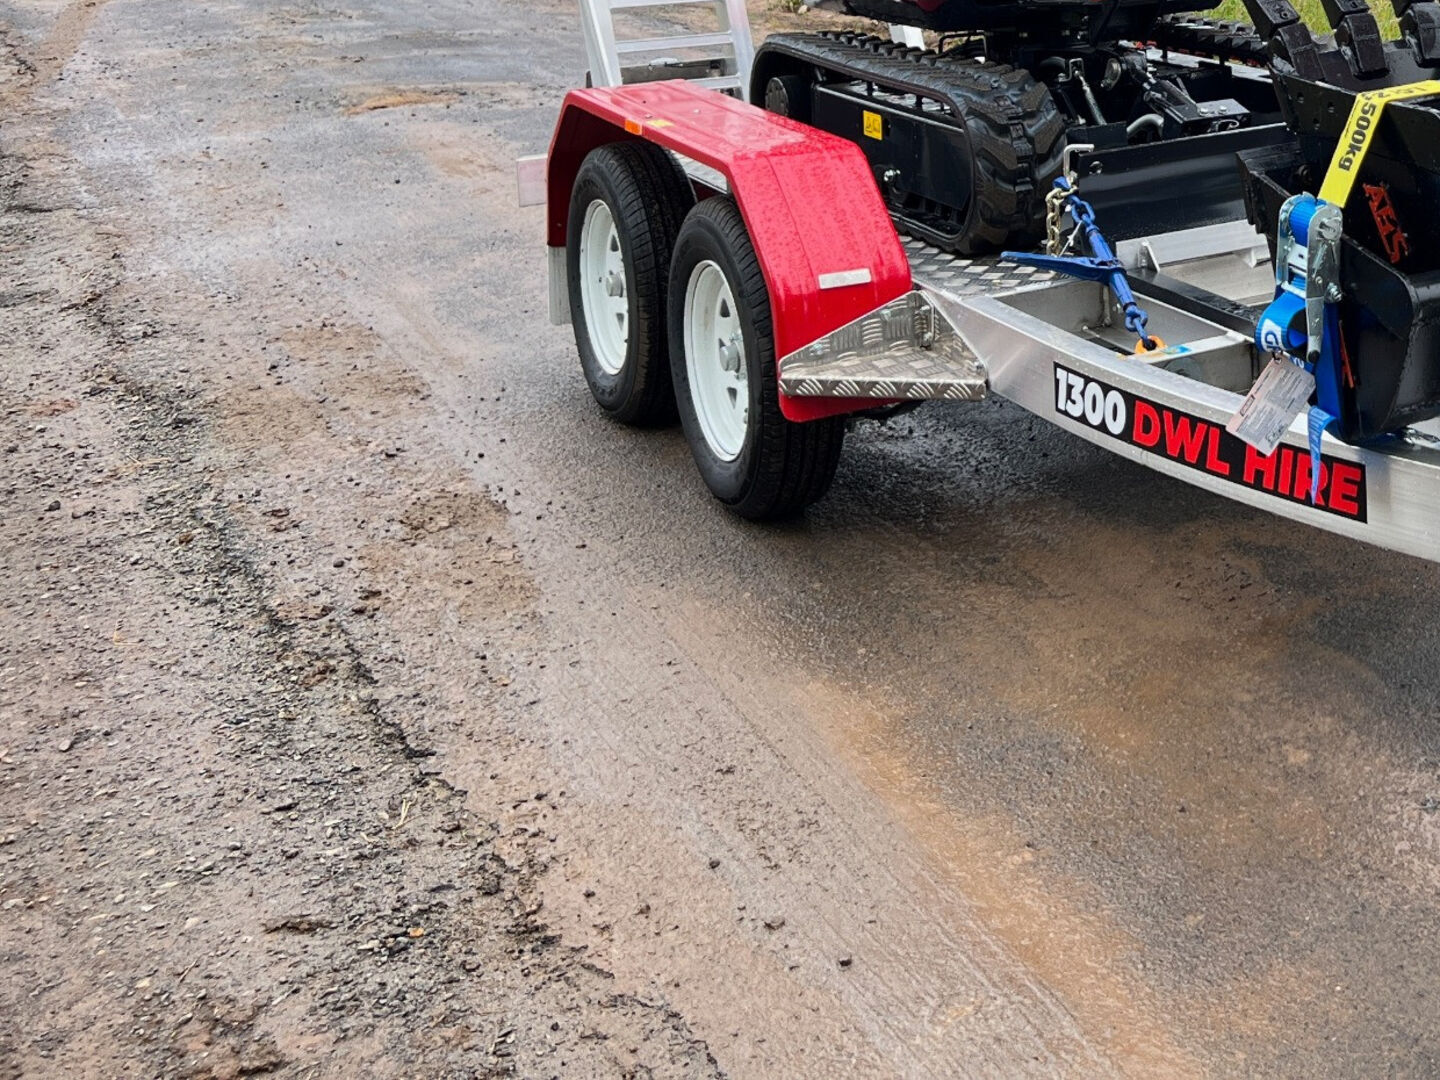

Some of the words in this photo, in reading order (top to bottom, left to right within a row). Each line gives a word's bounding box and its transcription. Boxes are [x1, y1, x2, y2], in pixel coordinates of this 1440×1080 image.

[1056, 367, 1126, 435] 1300
[1132, 400, 1231, 476] DWL
[1243, 442, 1362, 516] HIRE
